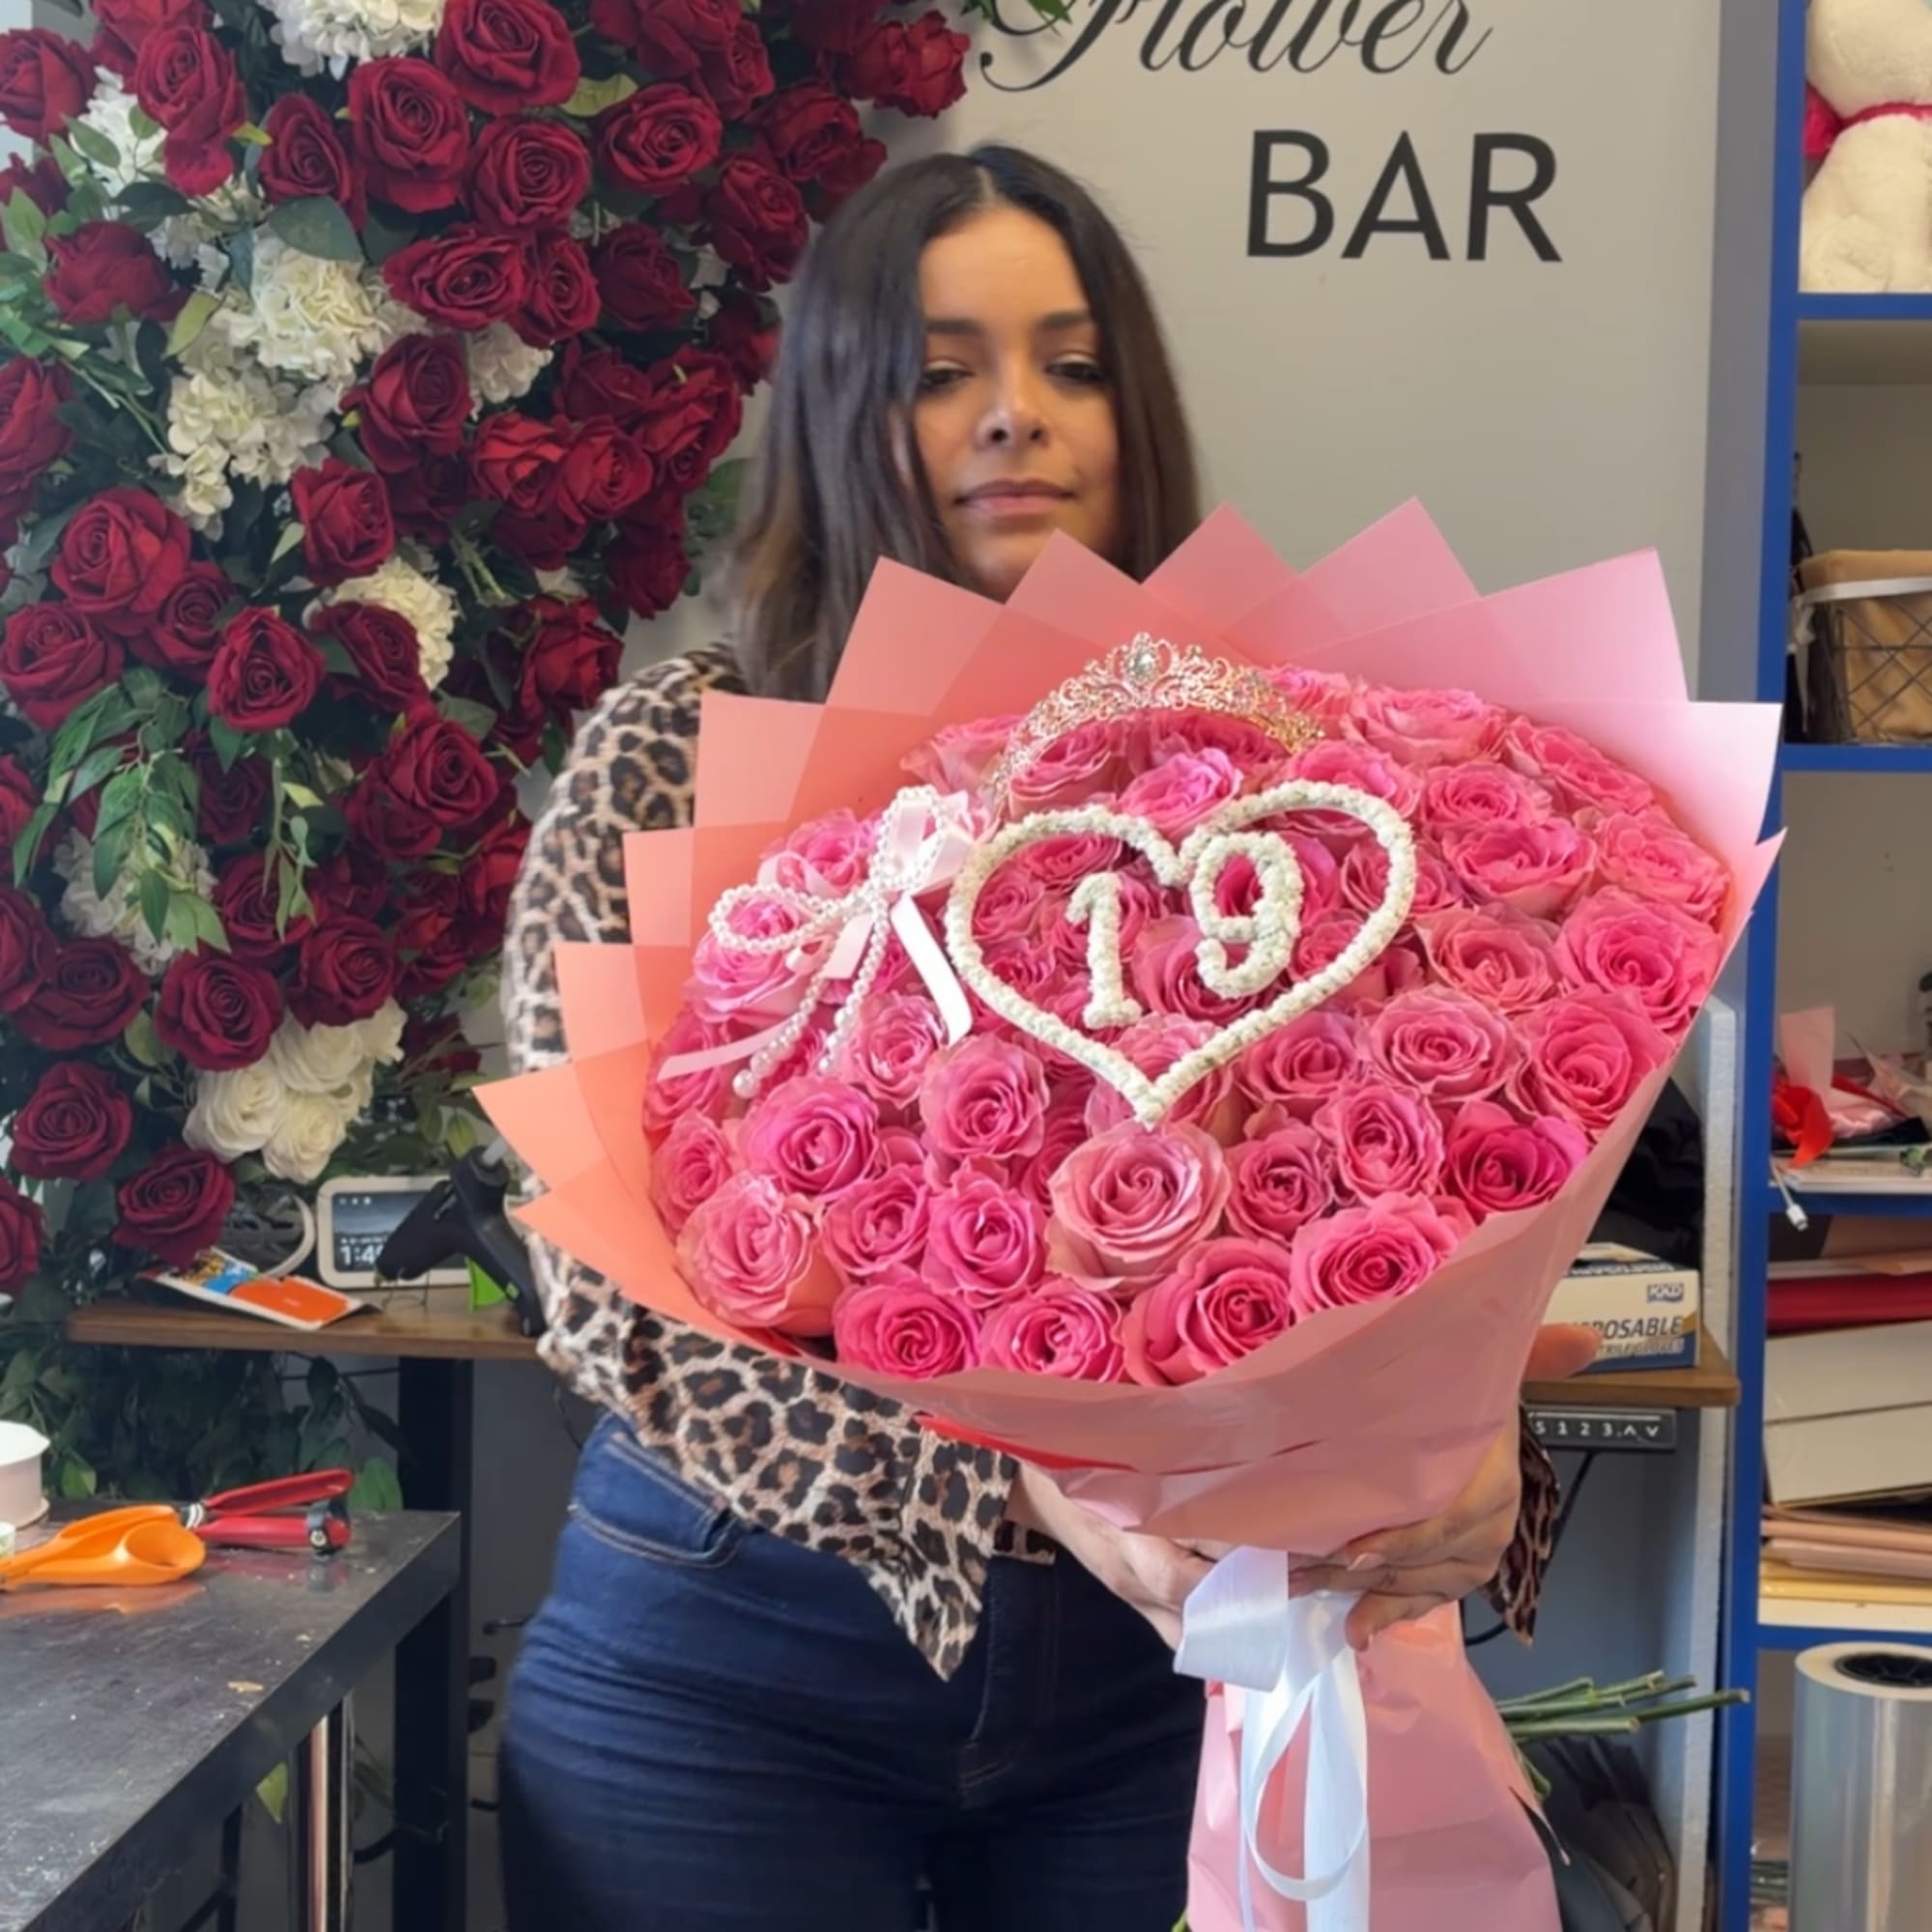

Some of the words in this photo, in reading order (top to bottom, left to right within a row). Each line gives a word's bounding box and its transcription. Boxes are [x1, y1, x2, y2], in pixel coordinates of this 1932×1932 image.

[1247, 129, 1562, 262] BAR
[1066, 832, 1303, 1029] 19
[1573, 1316, 1683, 1340] POSABLE
[1579, 1422, 1590, 1436] 2
